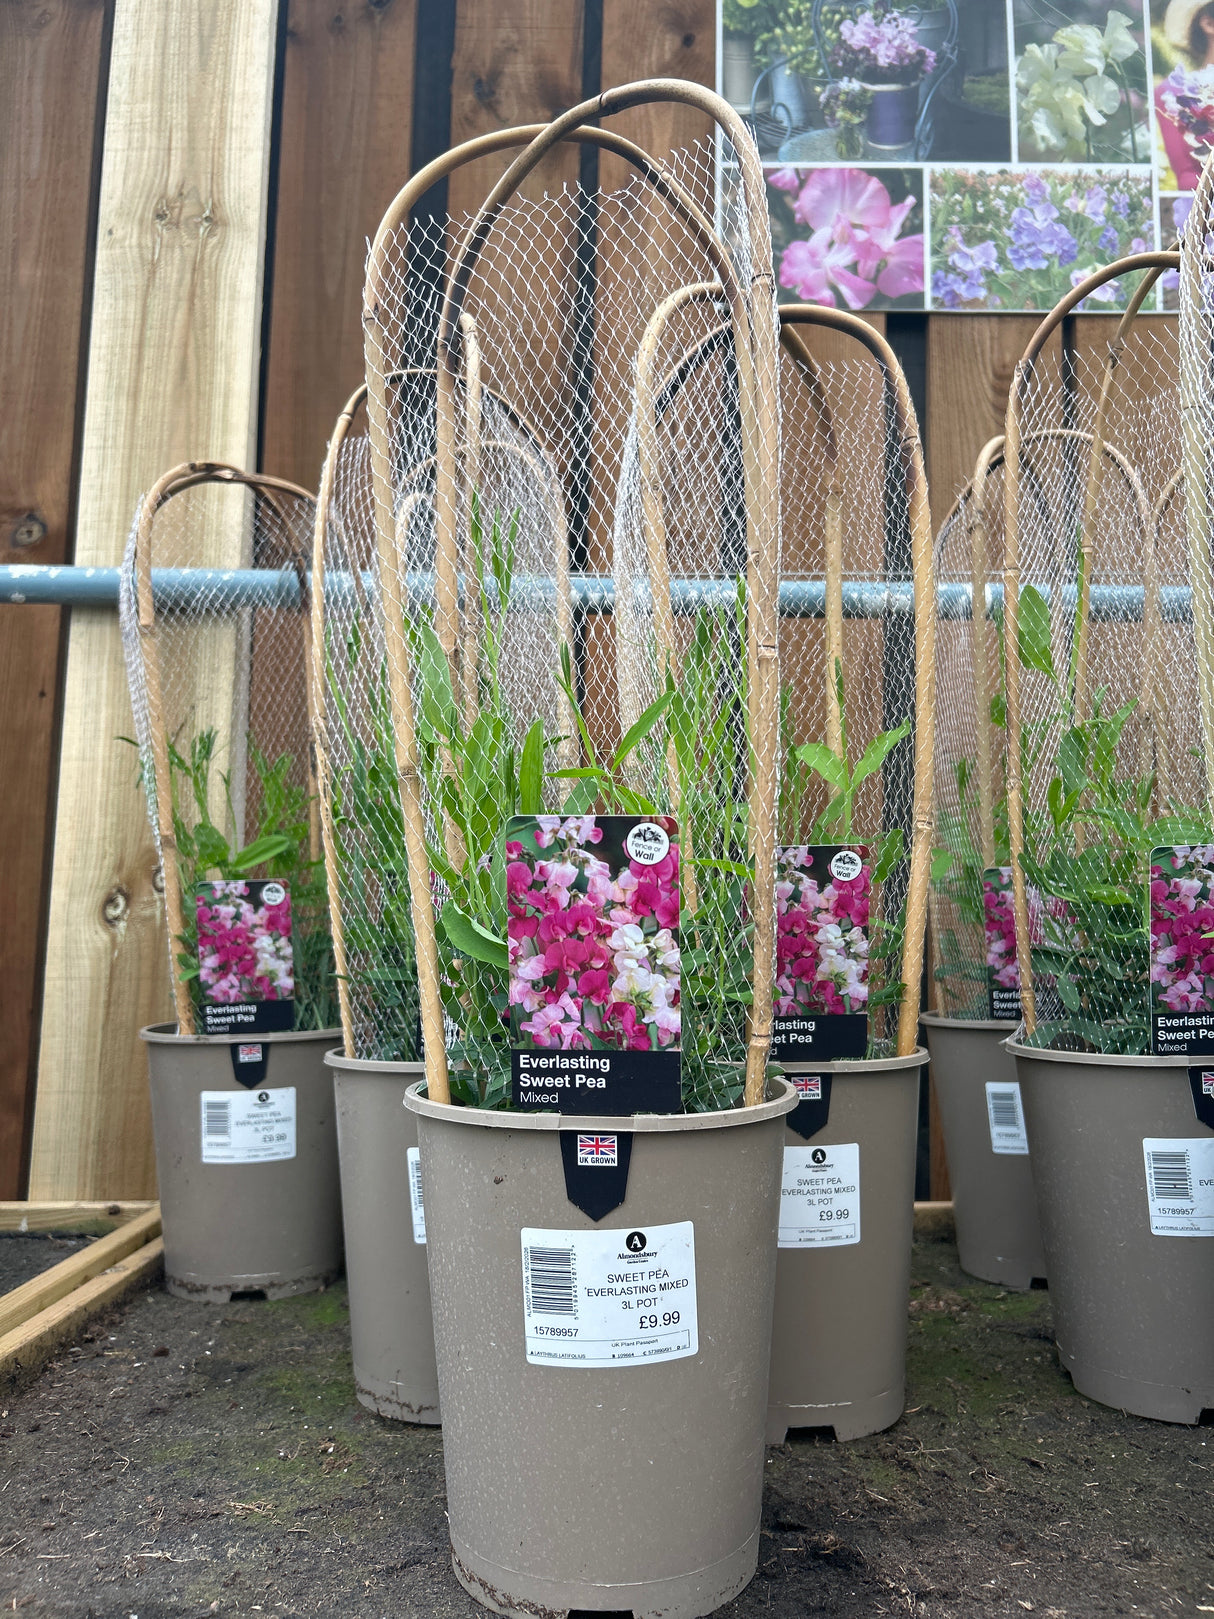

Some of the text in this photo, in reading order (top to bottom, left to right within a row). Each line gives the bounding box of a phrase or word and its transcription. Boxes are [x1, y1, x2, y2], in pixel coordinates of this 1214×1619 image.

[631, 840, 653, 851] Fence
[634, 849, 655, 861] Wall
[836, 869, 851, 878] Wall
[206, 1004, 257, 1015] Everlasting
[206, 1013, 256, 1025] Sweet Pea
[206, 1024, 230, 1033] Mixed
[1157, 1028, 1214, 1041] Sweet Pe
[789, 1032, 813, 1044] Pea
[1157, 1042, 1188, 1052] Mixed
[519, 1054, 610, 1073] Everlasting
[519, 1073, 607, 1089] Sweet Pea
[520, 1091, 559, 1104] Mixed
[579, 1156, 616, 1165] UK GROWN
[796, 1177, 842, 1186] SWEET PEA
[781, 1185, 856, 1196] EVERLASTING MIXED
[806, 1197, 833, 1206] 3L POT
[819, 1208, 850, 1221] £9.99
[1157, 1207, 1196, 1216] 15789957
[616, 1251, 658, 1260] Almondsbury
[607, 1268, 670, 1284] SWEET PEA
[586, 1278, 689, 1297] EVERLASTING MIXED
[621, 1297, 658, 1310] 3L POT
[639, 1310, 681, 1330] £9.99
[534, 1325, 579, 1337] 15789957
[635, 1338, 659, 1346] Passport
